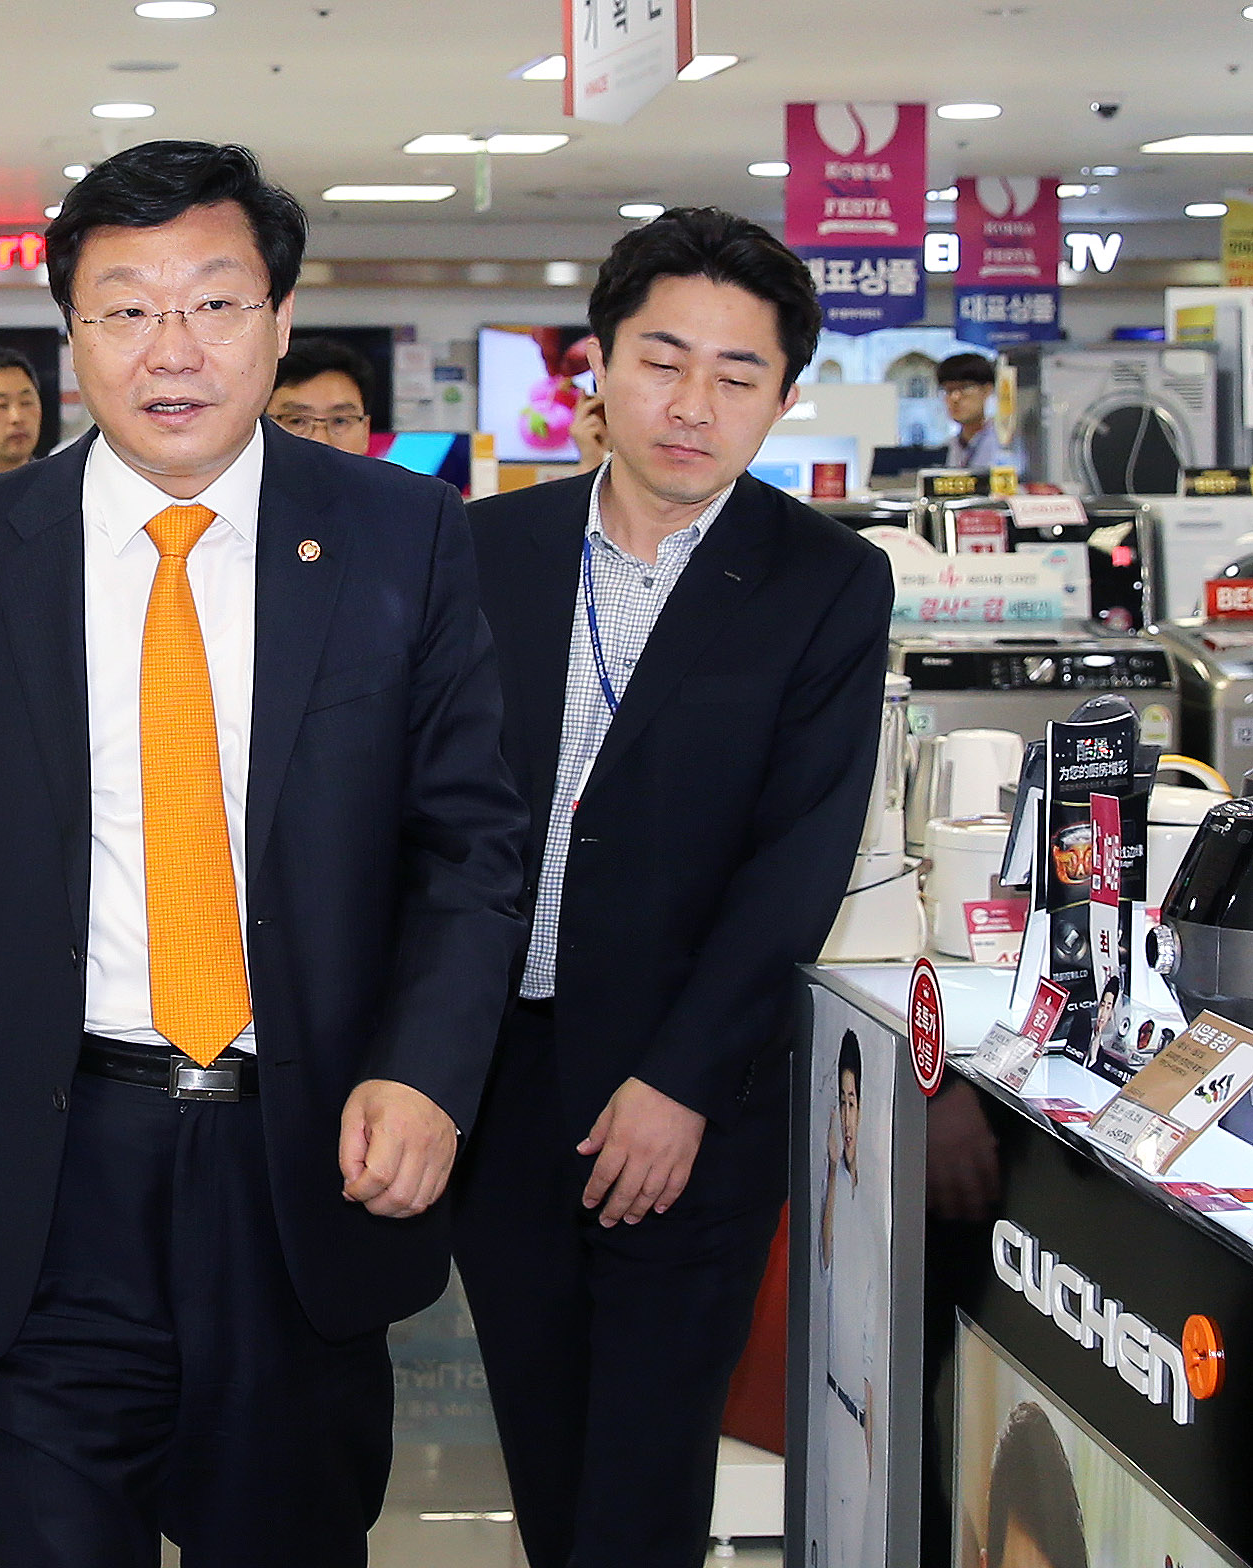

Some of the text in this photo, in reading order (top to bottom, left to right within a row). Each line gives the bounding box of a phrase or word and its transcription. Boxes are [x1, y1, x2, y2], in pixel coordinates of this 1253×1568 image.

[1065, 232, 1123, 273] TV
[917, 1037, 933, 1074] 상품
[992, 1219, 1189, 1426] CUCHEN
